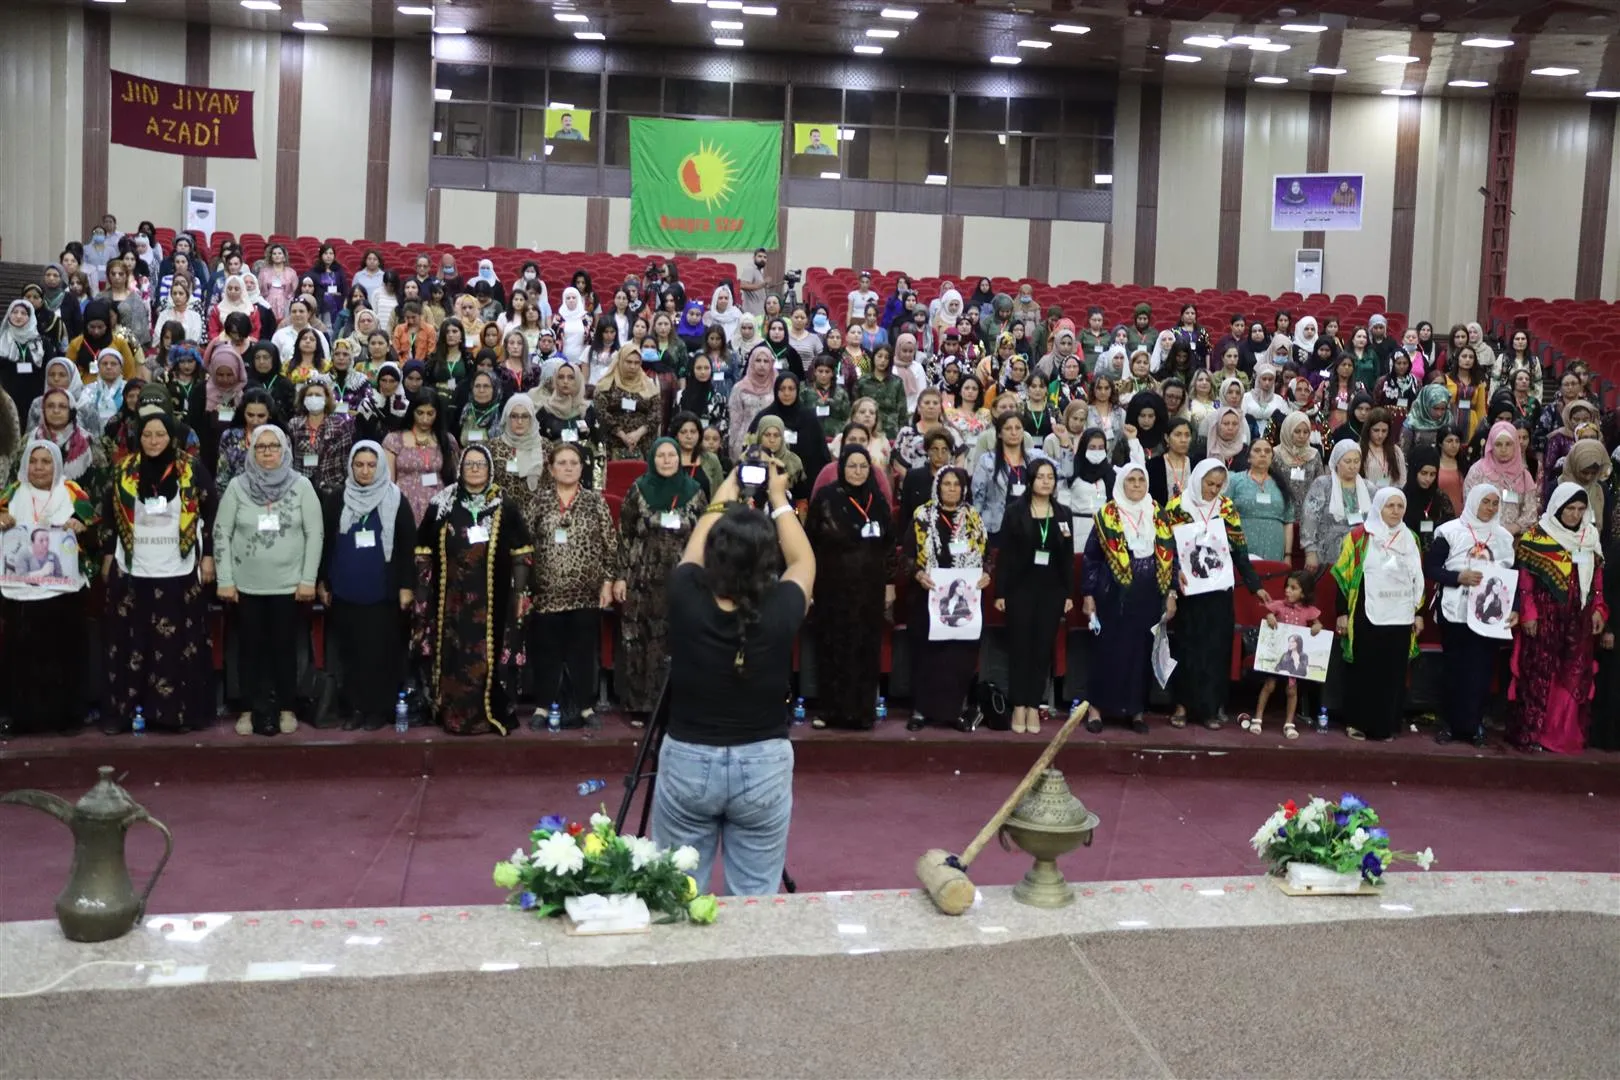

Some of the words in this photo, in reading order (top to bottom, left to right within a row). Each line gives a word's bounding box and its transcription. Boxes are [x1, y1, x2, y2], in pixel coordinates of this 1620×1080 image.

[121, 80, 159, 106] JIN
[172, 88, 239, 115] JIYAN
[715, 216, 744, 233] Star
